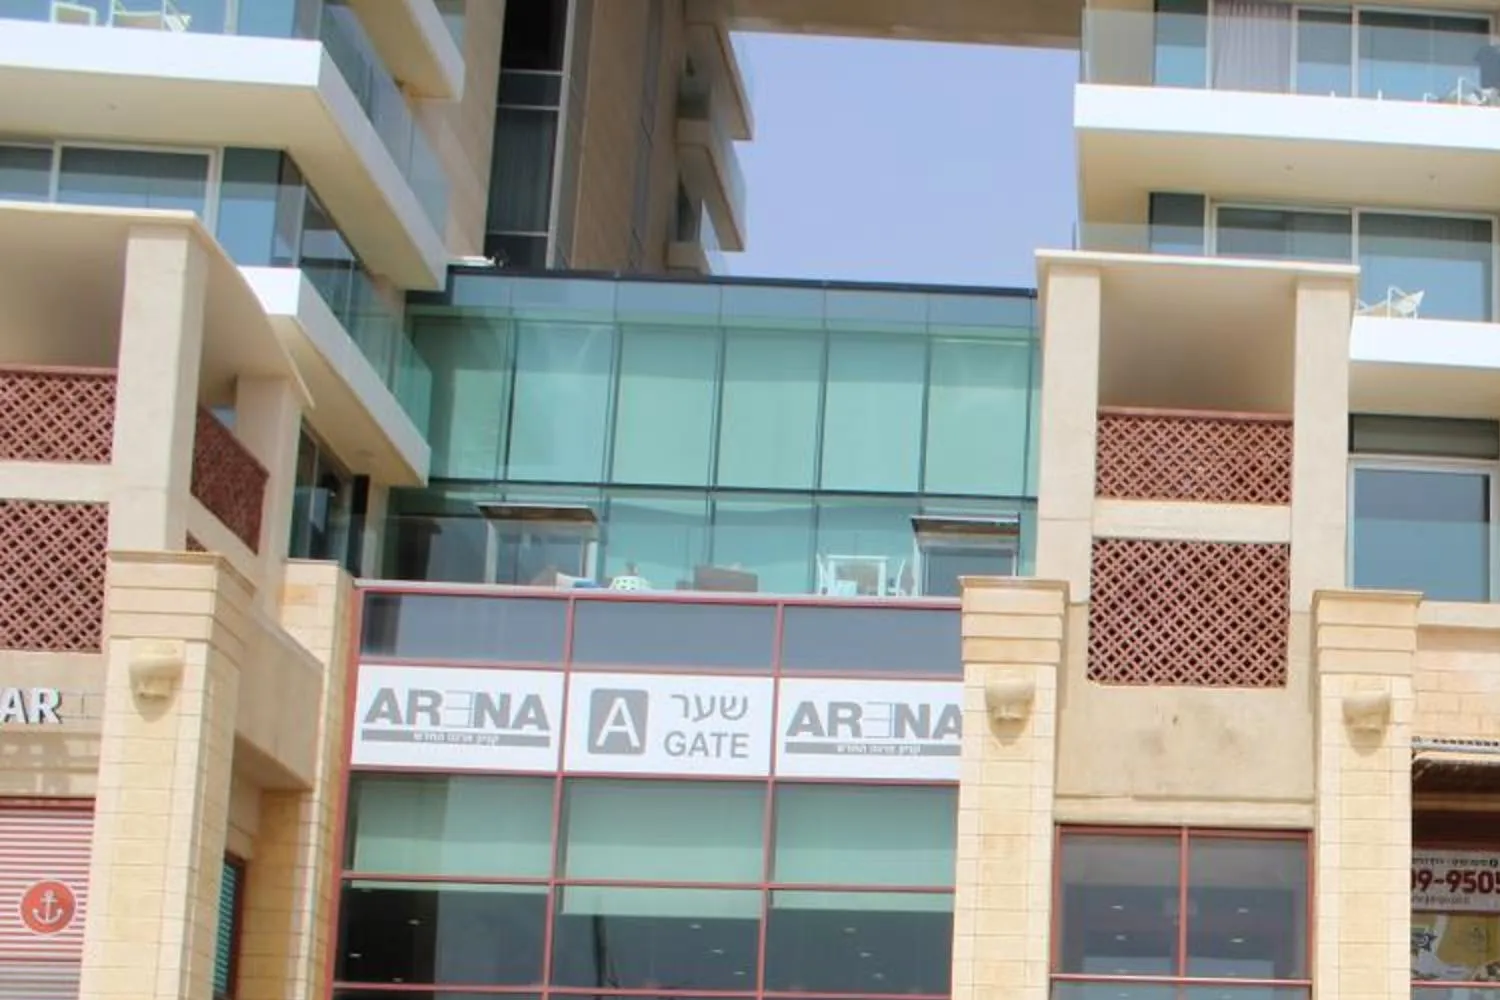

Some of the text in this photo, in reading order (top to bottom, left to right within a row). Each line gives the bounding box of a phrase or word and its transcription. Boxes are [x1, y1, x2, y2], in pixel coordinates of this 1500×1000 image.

[363, 687, 551, 731] ARENA
[596, 697, 641, 748] A
[670, 694, 748, 722] שער
[785, 700, 962, 739] ARENA
[664, 730, 750, 759] GATE
